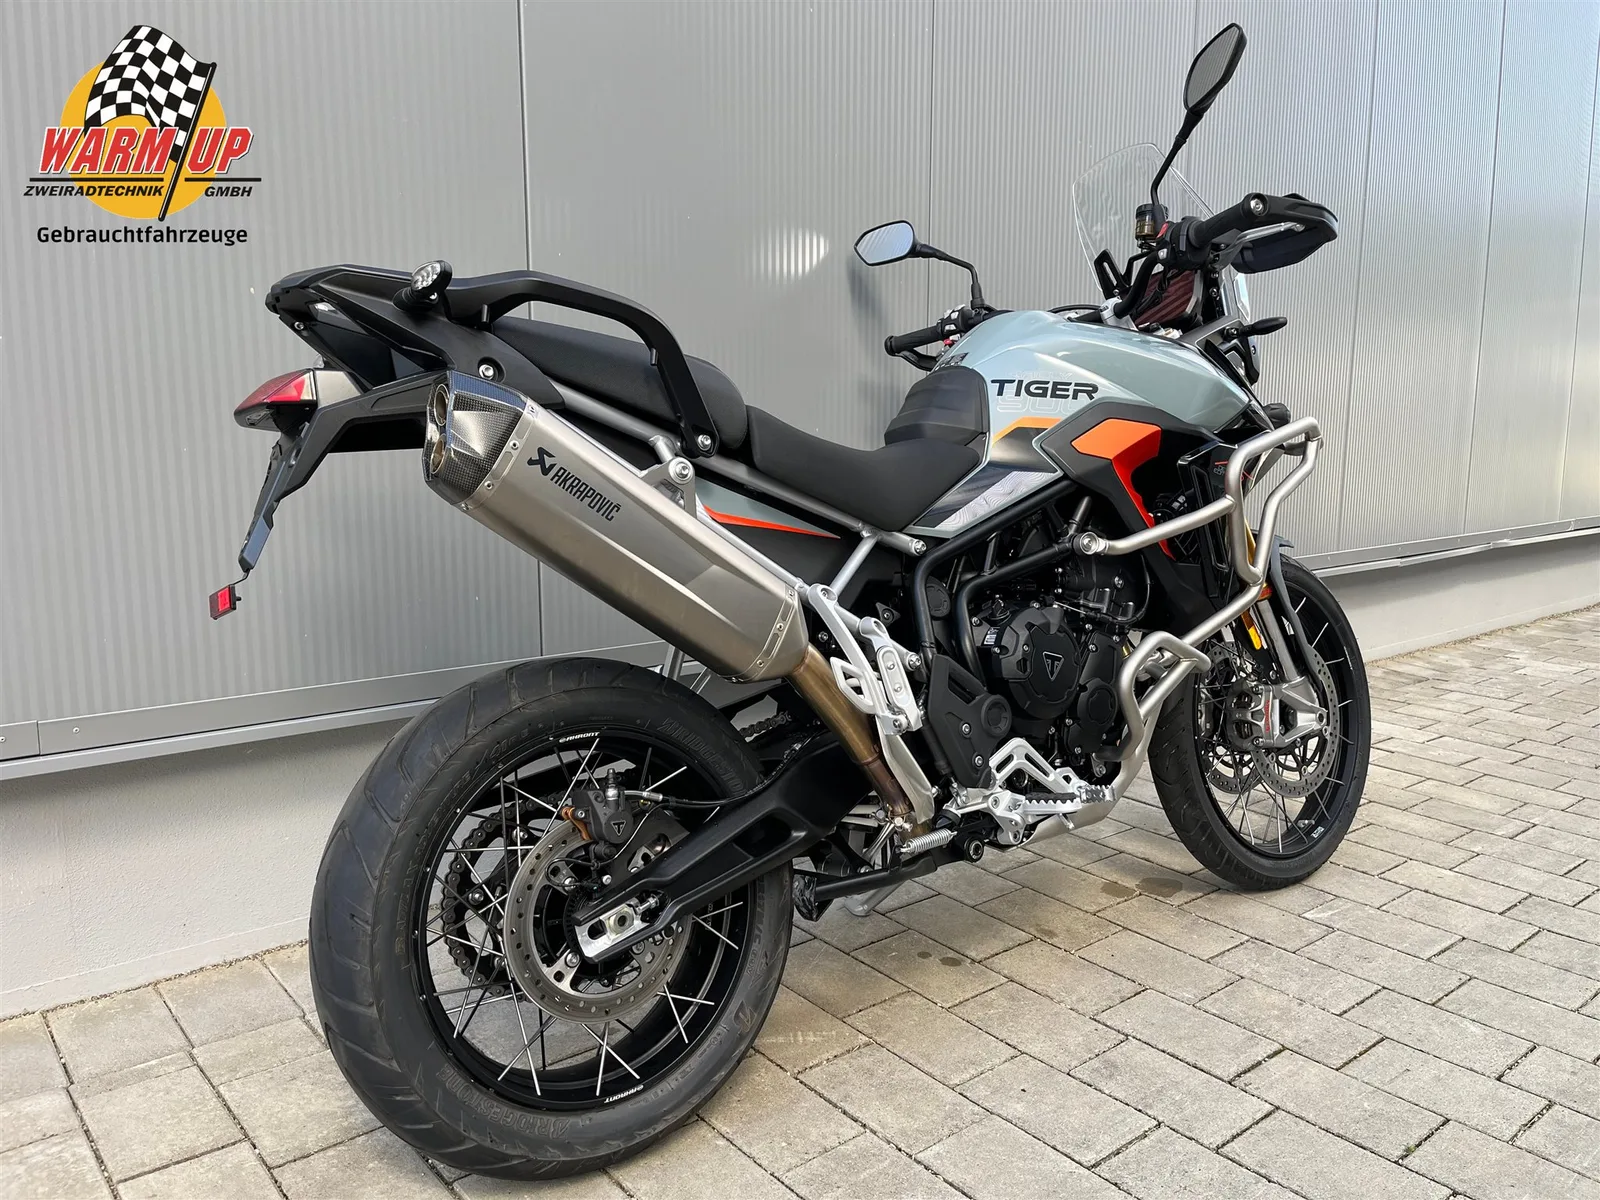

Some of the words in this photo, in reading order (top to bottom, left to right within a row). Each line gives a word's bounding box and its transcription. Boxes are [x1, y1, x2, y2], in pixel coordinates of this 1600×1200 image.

[990, 379, 1099, 401] TIGER
[550, 466, 622, 522] AKRAPOVIČ
[436, 1062, 571, 1140] BRIDGESTONE
